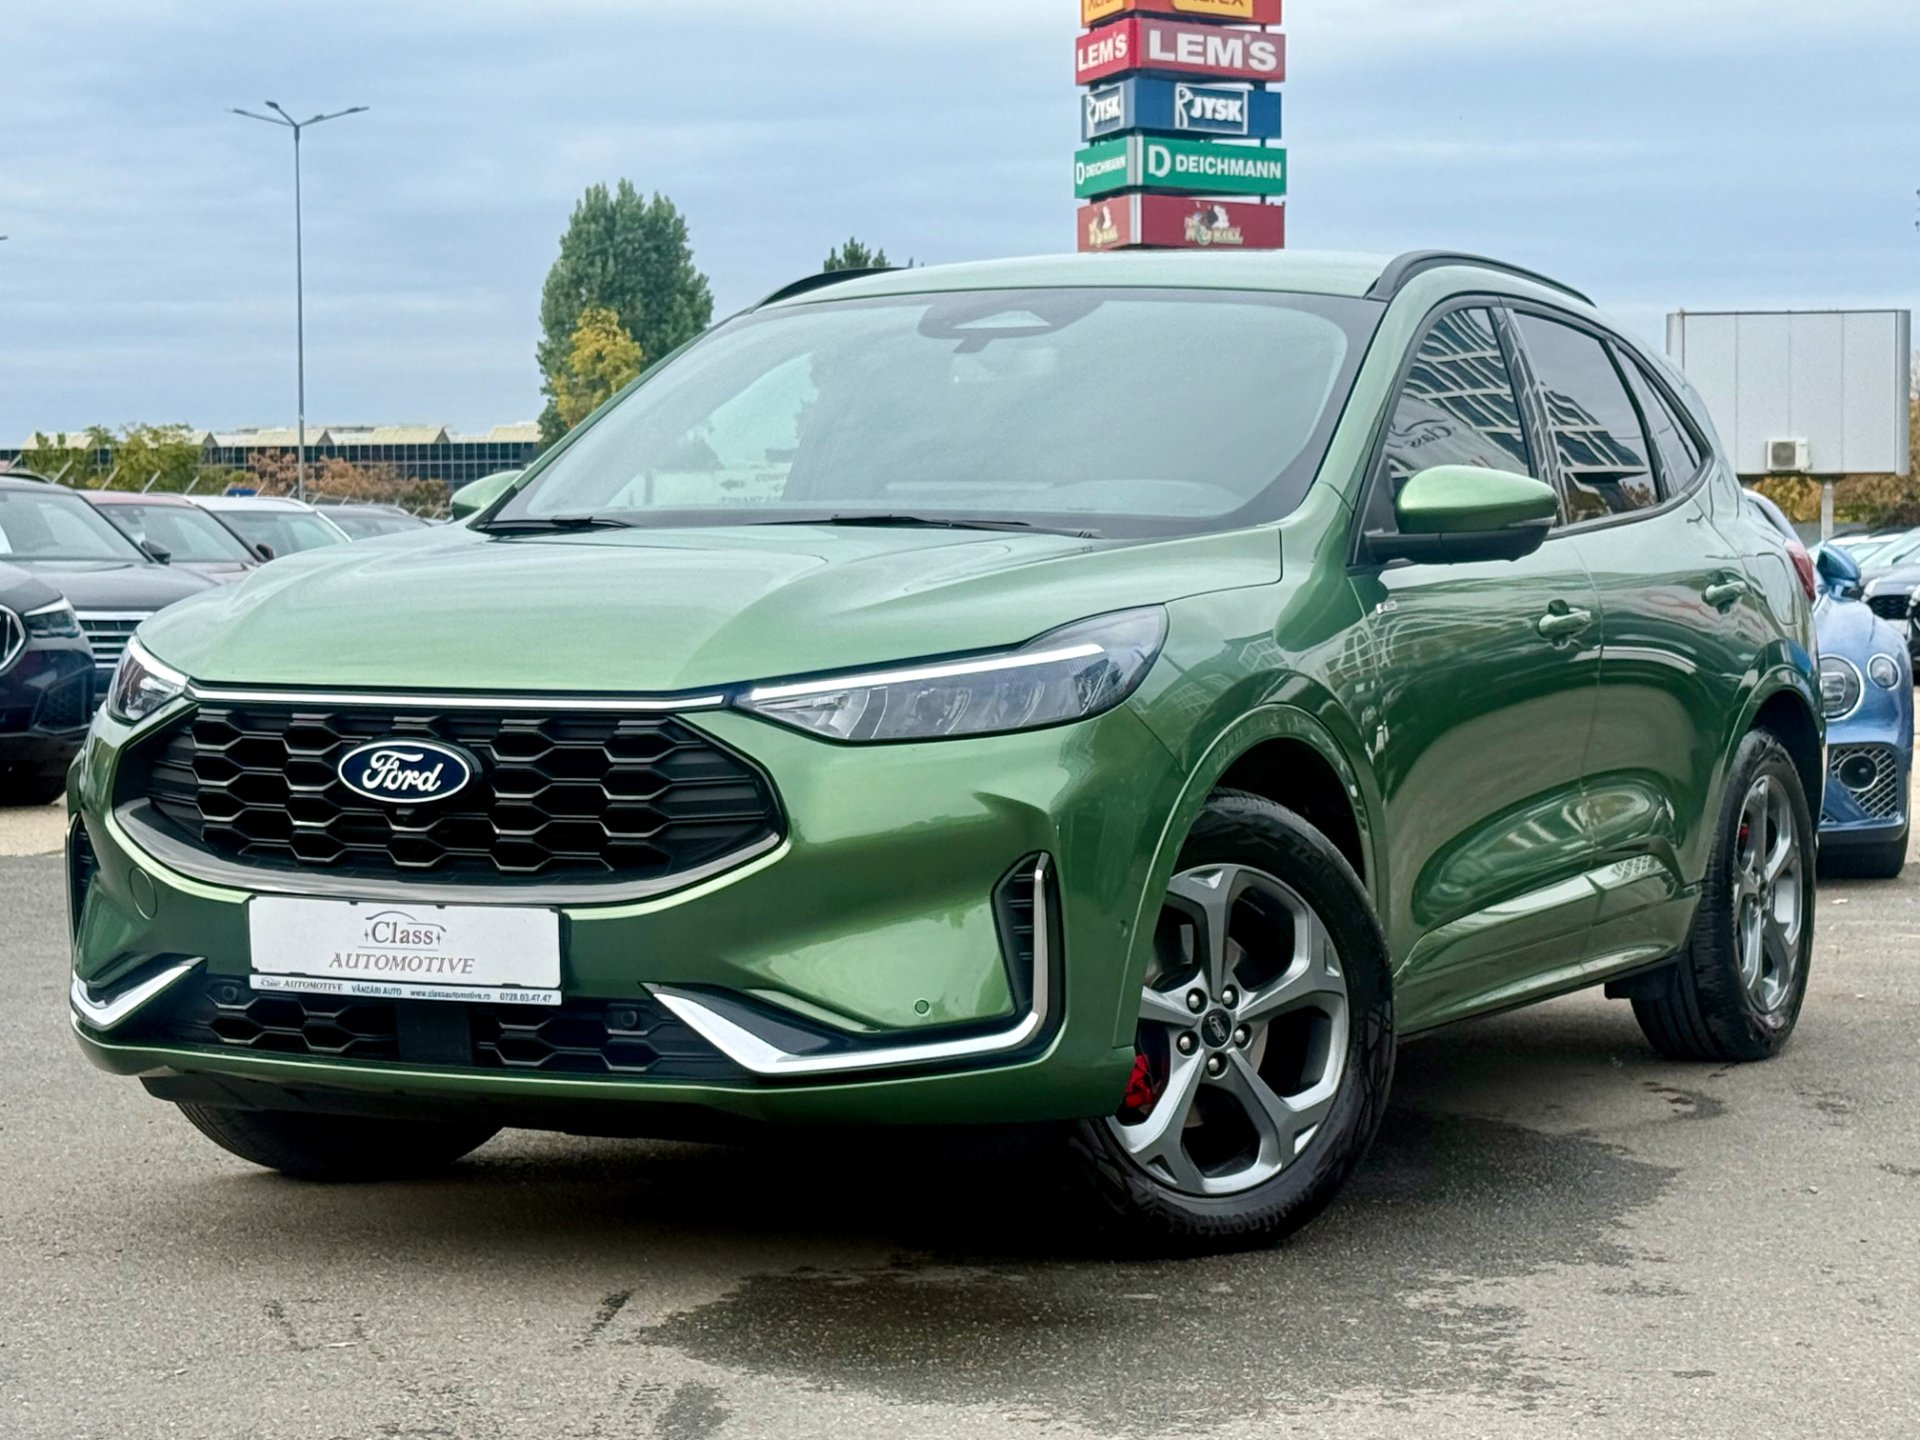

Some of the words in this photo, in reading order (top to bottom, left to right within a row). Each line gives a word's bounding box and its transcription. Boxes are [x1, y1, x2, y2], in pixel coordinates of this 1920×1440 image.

[1078, 33, 1128, 72] LEM'S
[1150, 30, 1277, 72] LEM'S
[1093, 96, 1121, 123] JYSK
[1190, 96, 1243, 123] JYSK
[1148, 144, 1172, 178] D
[1175, 154, 1282, 179] DEICHMANN
[362, 750, 443, 792] Ford
[372, 920, 434, 945] Class
[329, 952, 475, 974] AUTOMOTIVE
[283, 980, 343, 992] AUTOMOTIVE
[382, 986, 402, 996] AUTO
